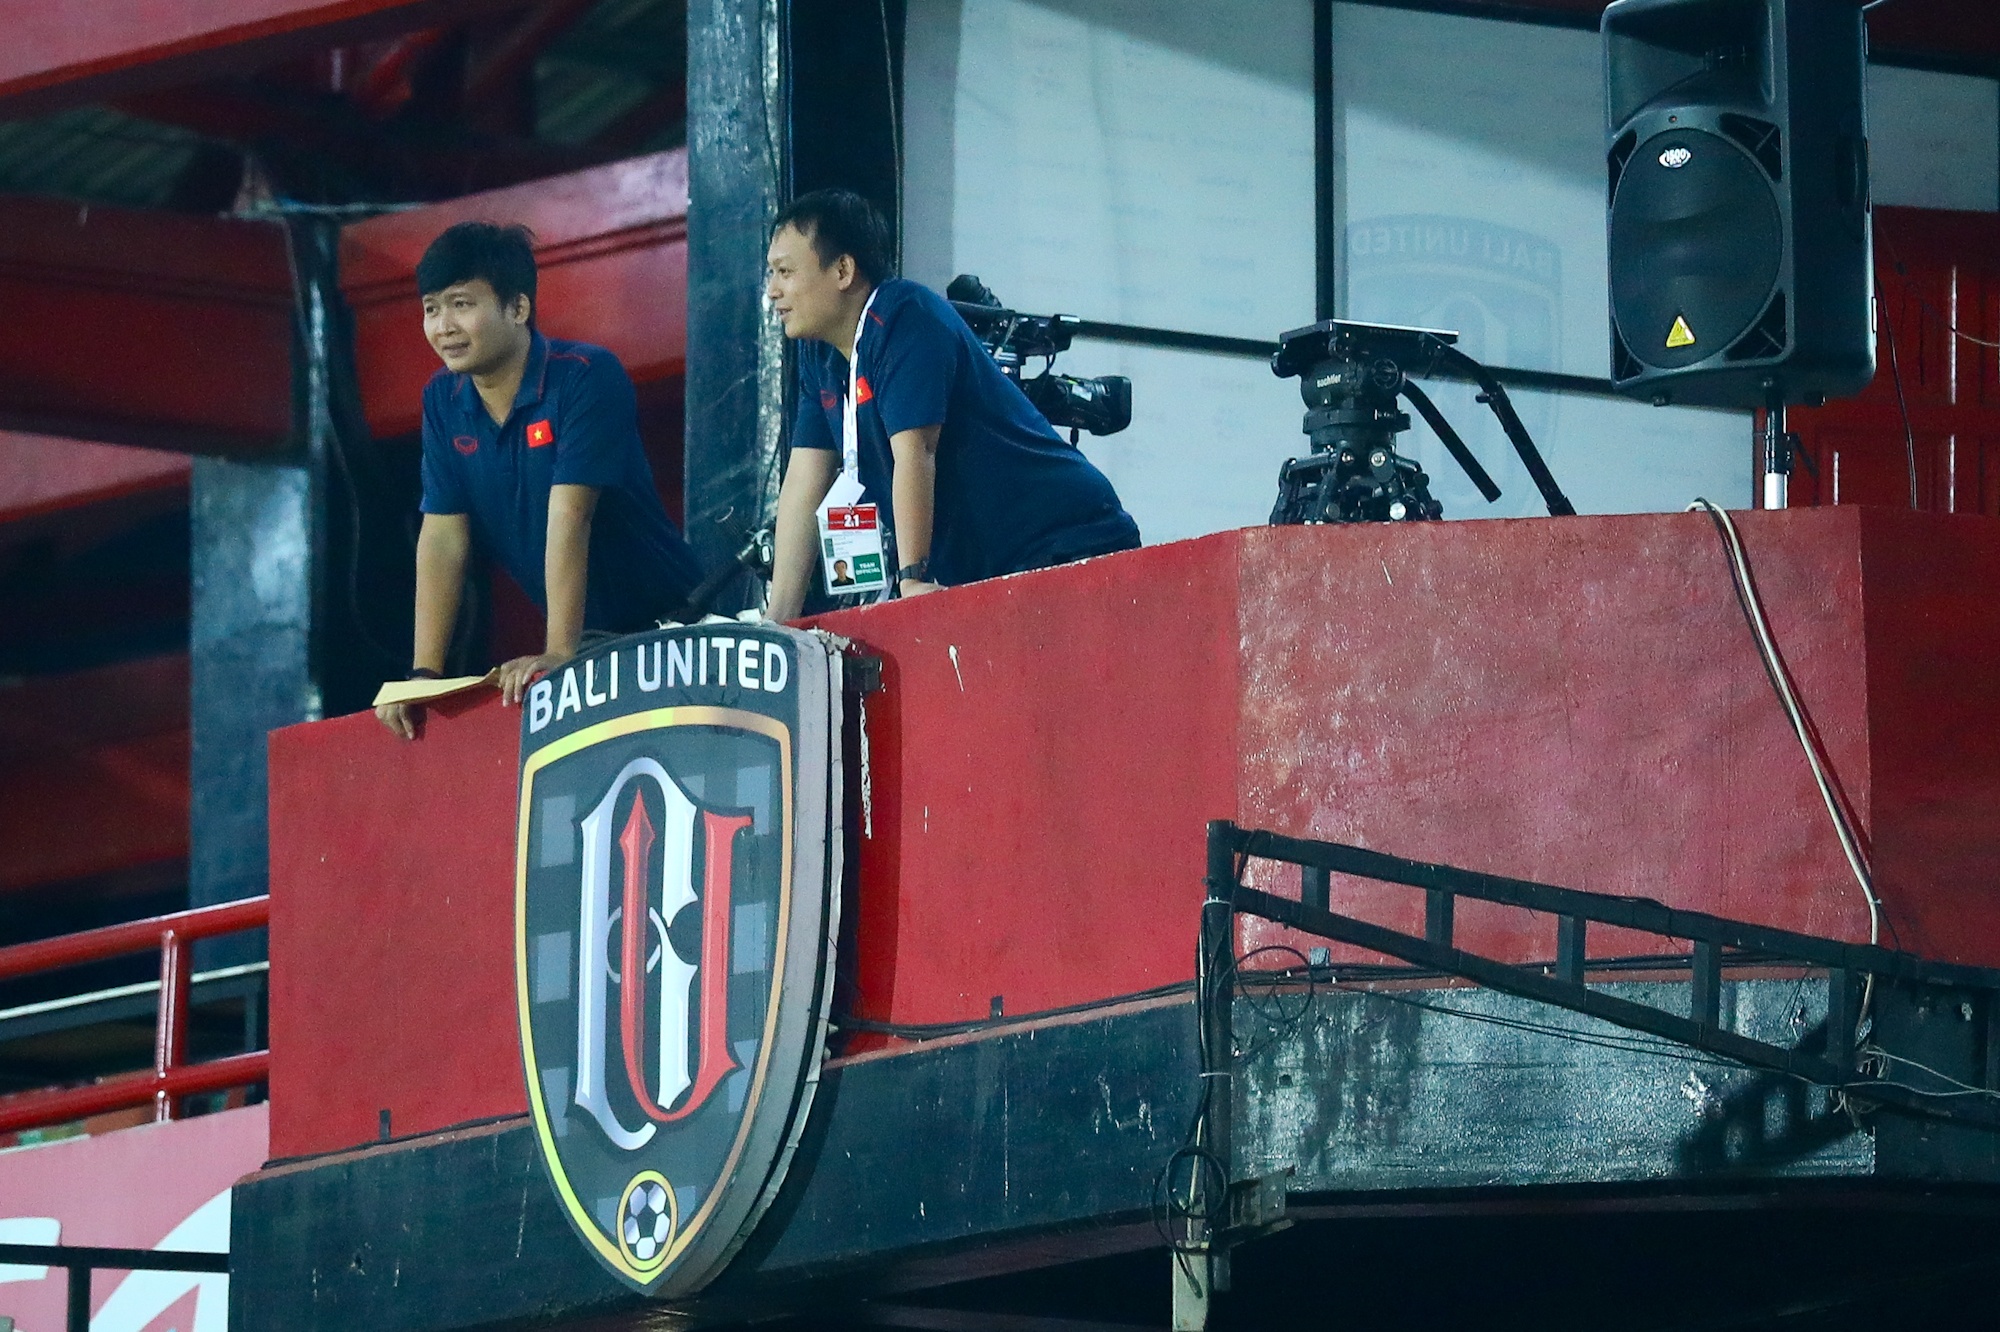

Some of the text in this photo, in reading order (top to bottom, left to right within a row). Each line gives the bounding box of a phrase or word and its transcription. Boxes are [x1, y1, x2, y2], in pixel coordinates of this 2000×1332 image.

[859, 561, 876, 569] TEAM
[529, 636, 788, 734] BALI UNITED
